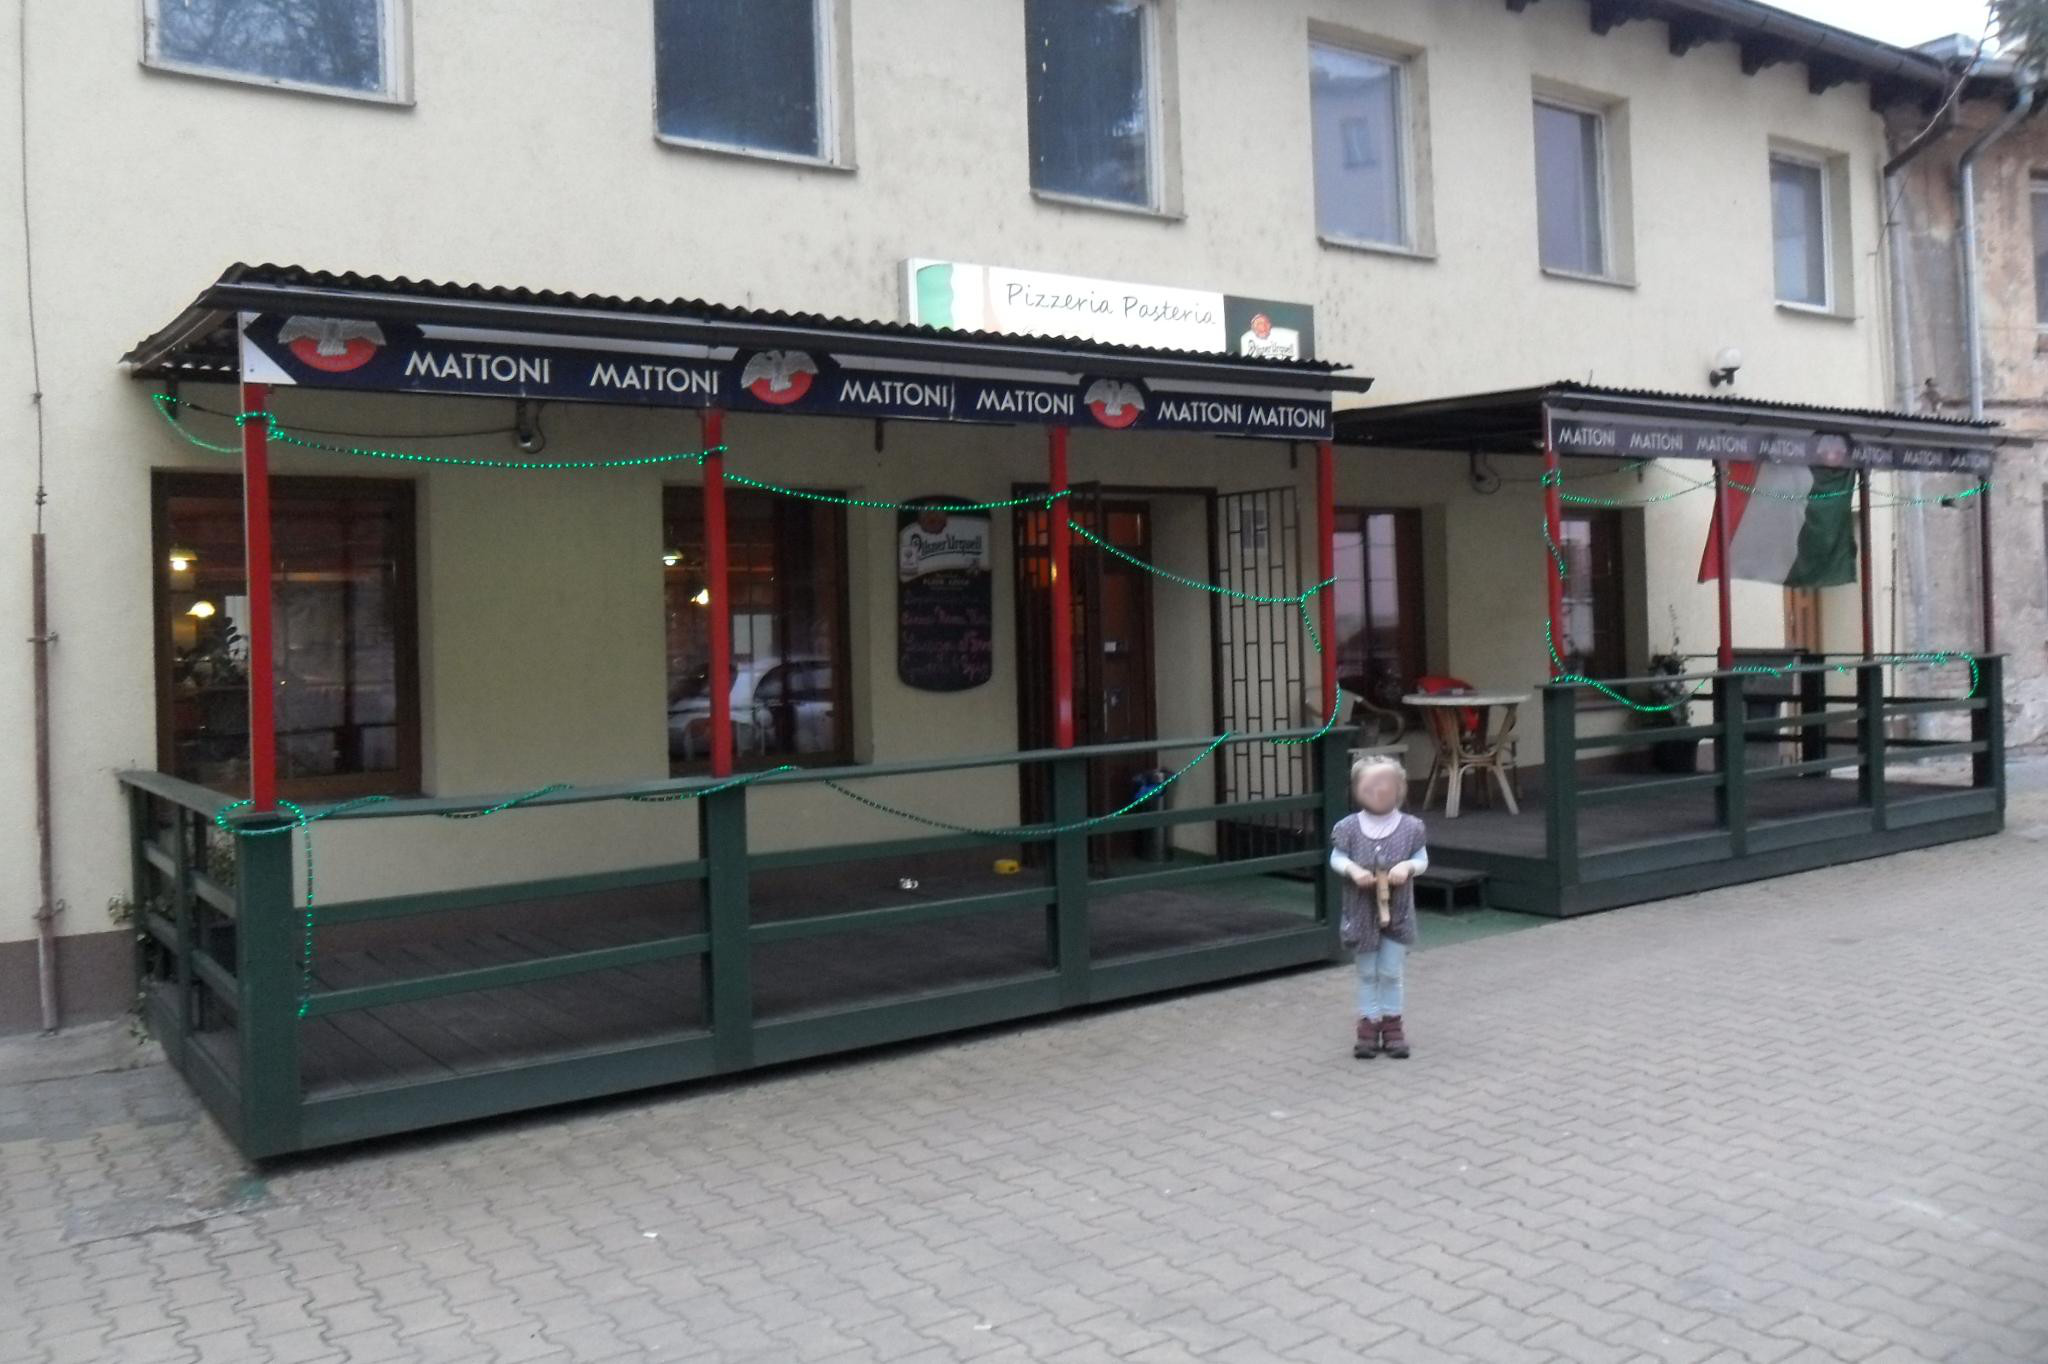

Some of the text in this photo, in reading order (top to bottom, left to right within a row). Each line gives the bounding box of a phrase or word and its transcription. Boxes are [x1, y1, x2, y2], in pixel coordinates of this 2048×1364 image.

[1006, 282, 1216, 325] Pizzeria Pasteria
[404, 350, 1326, 429] MATTONI MATTONI MATTONI MATTONI MATTONI MATTONI
[1558, 426, 1616, 447] MATTONI
[1629, 431, 1684, 451] MATTONI
[1696, 435, 1748, 453] MATTONI
[1758, 439, 1807, 457] MATTONI
[1852, 446, 1893, 464] MATTONI
[1903, 449, 1944, 466] MATTONI
[944, 533, 982, 555] Urquell
